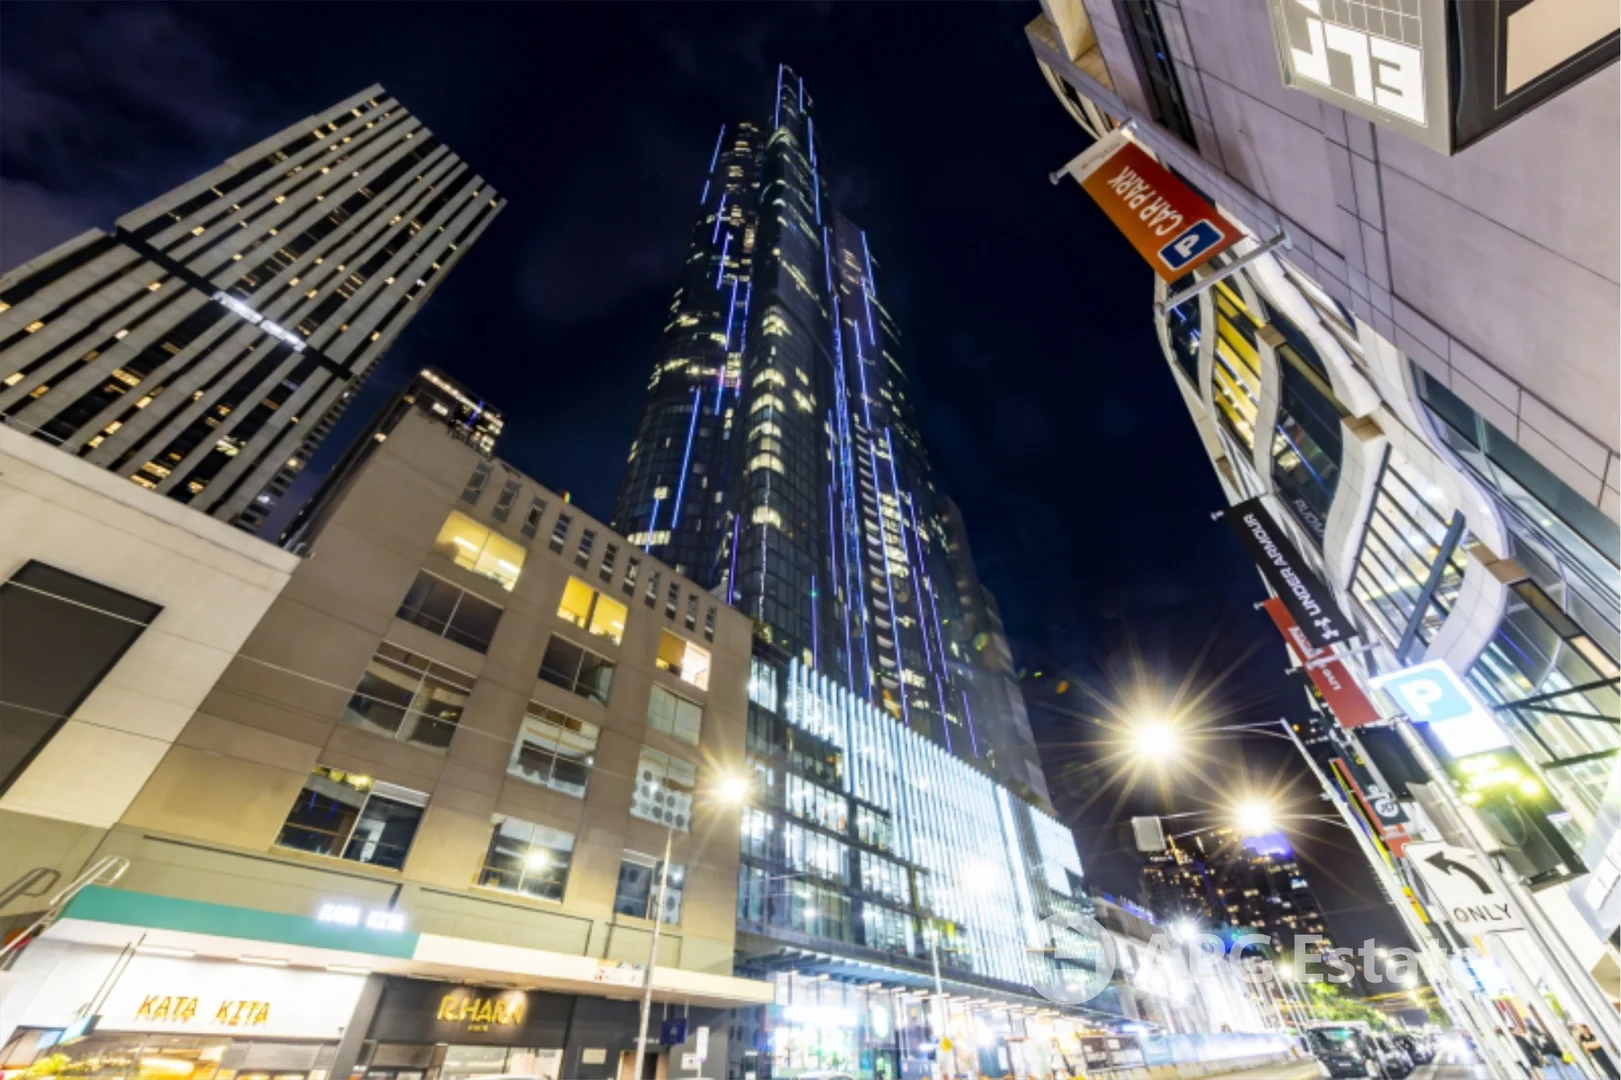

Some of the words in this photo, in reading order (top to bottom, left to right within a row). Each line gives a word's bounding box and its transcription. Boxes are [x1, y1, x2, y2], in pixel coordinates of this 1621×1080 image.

[1107, 166, 1156, 210] PARK
[1139, 196, 1183, 236] CAR
[1174, 234, 1200, 258] P
[1243, 512, 1289, 566] ARMOUR
[1280, 566, 1321, 616] UNDER
[1398, 678, 1443, 719] P
[1453, 902, 1512, 922] ONLY
[135, 994, 199, 1020] KATA
[214, 1000, 270, 1025] KITA
